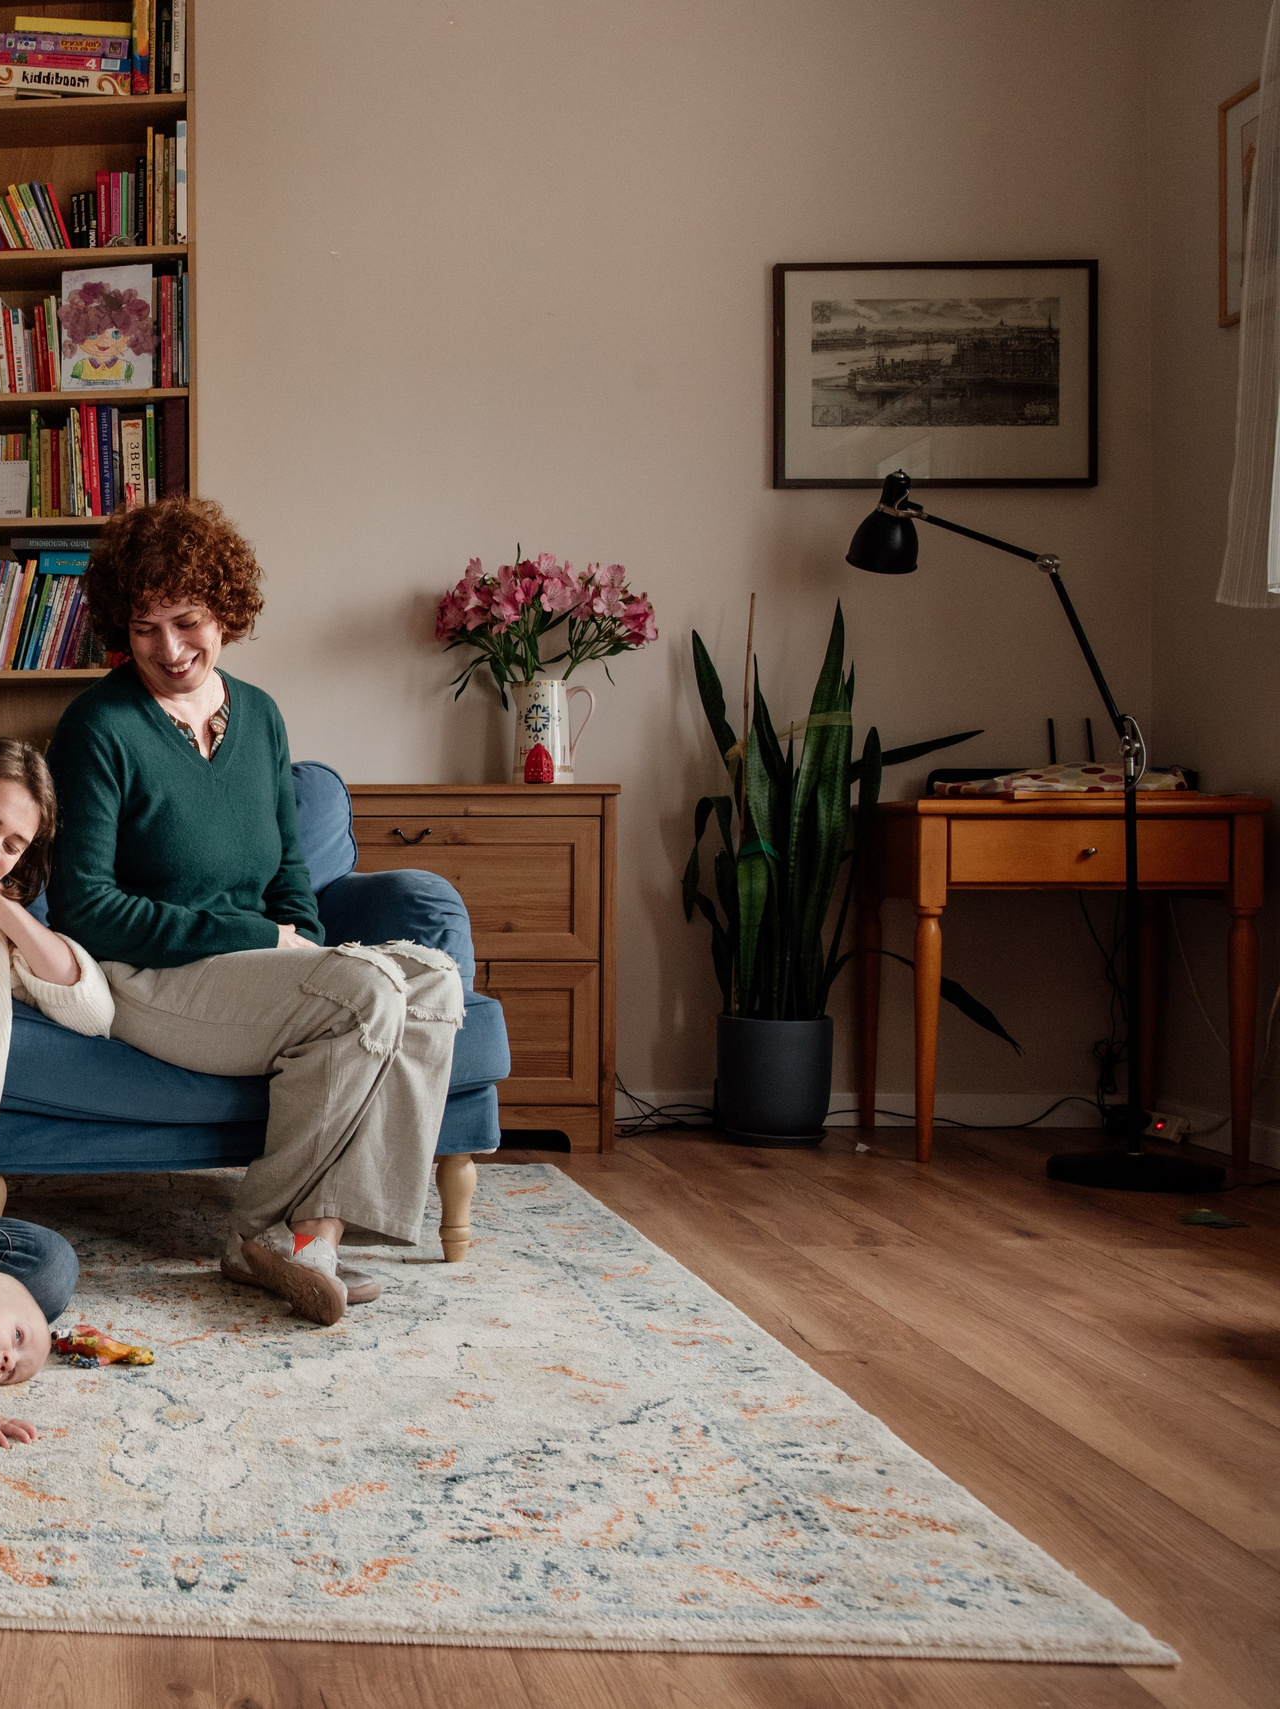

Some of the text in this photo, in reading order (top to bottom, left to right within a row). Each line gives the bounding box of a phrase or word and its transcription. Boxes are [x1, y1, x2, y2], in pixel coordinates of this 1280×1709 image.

[85, 58, 97, 69] 4
[22, 69, 89, 87] kiddiboom
[15, 356, 23, 381] МАРШАК
[100, 411, 108, 441] ГРЕЦИИ
[101, 445, 109, 478] ДРЕВНЕЙ
[127, 441, 143, 491] ЗВЕРИ
[28, 539, 90, 548] Тело человека
